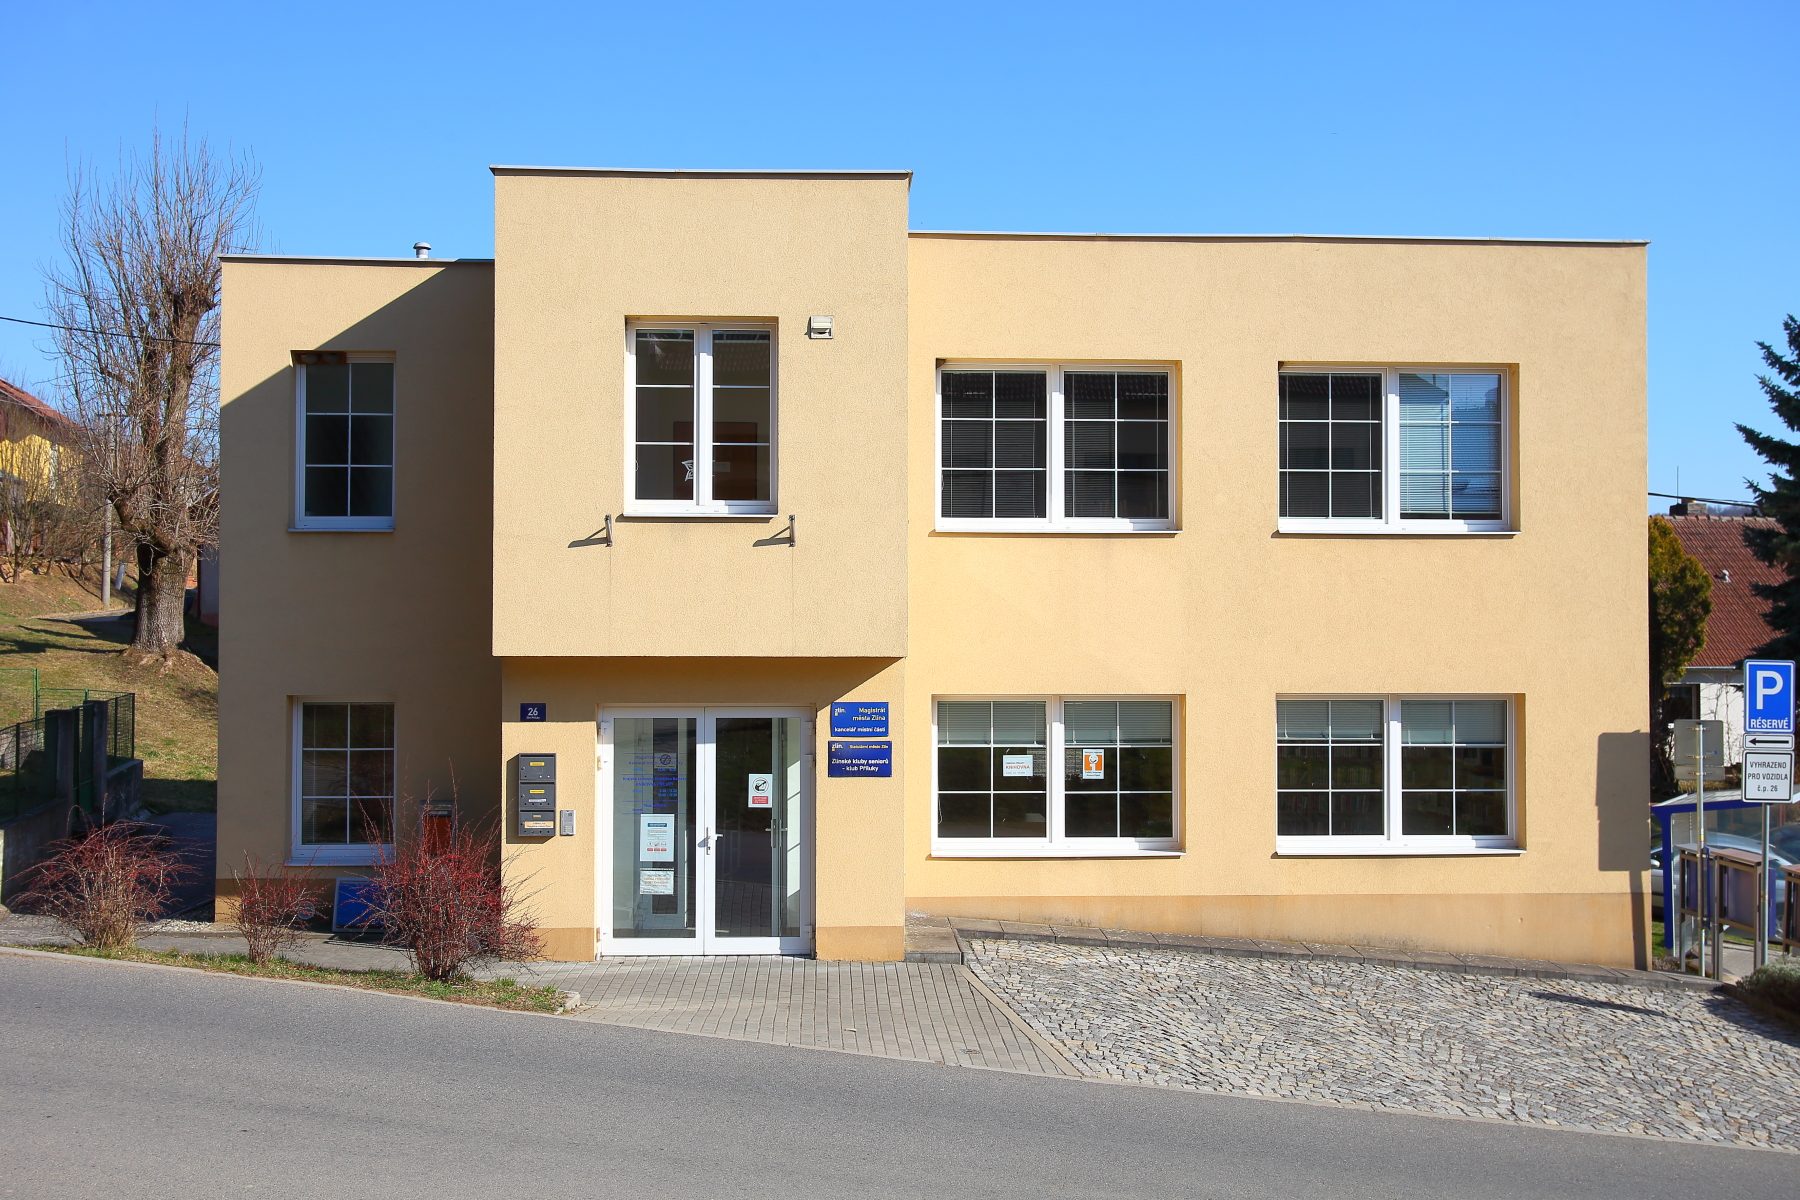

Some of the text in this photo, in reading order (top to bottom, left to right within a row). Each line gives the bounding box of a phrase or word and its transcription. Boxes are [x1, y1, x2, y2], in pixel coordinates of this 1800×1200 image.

[1756, 670, 1784, 710] P
[527, 707, 539, 716] 26
[1750, 717, 1789, 729] RÉSERVÉ
[1749, 761, 1787, 769] VYHRAZENO
[1762, 773, 1789, 781] VOZIDLA
[1770, 784, 1778, 792] 26
